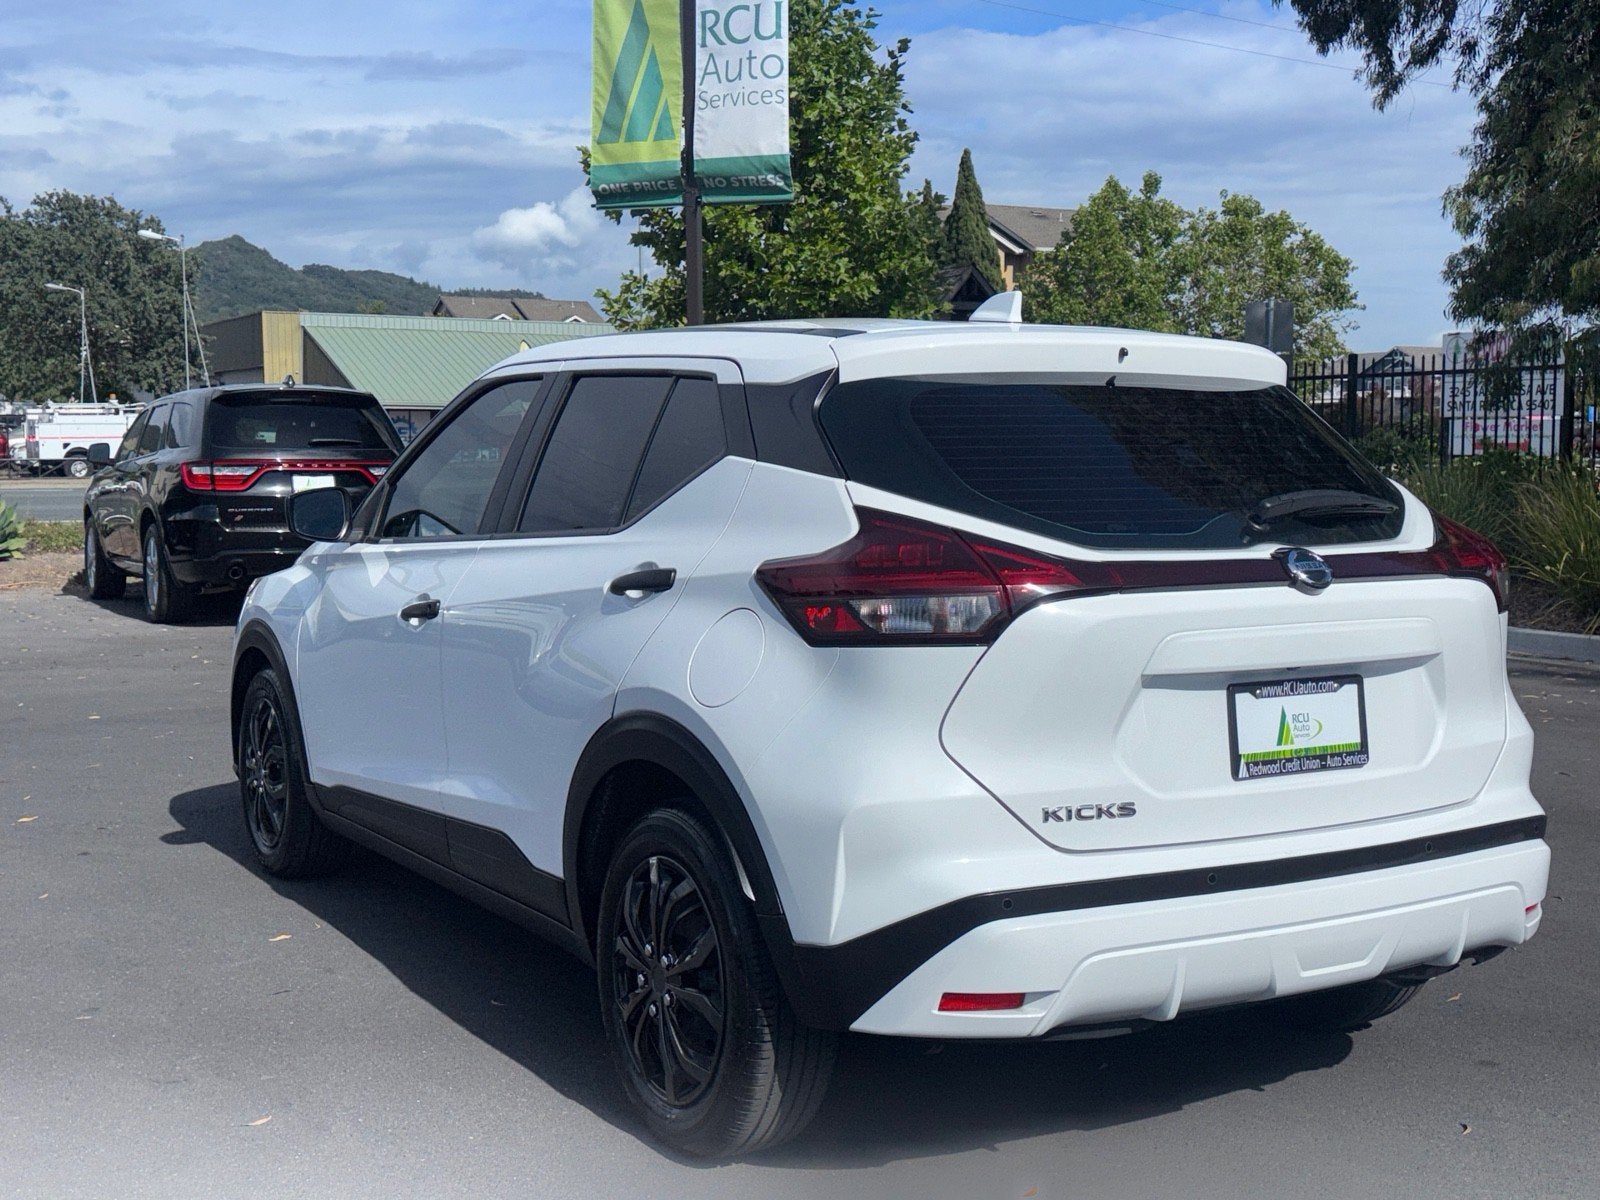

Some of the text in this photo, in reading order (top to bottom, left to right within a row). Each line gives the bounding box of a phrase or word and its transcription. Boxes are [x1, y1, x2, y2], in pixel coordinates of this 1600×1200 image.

[700, 1, 782, 48] RCU
[700, 50, 784, 86] Auto
[699, 86, 785, 110] Services
[598, 180, 677, 195] ONE PRICE
[703, 174, 784, 188] NO STRESS
[1261, 681, 1335, 696] www.RCUauto.com
[1292, 712, 1310, 724] RCU
[1293, 724, 1310, 732] Auto
[1249, 763, 1280, 776] Redwood
[1281, 760, 1300, 772] Credit
[1301, 757, 1320, 770] Union
[1327, 755, 1342, 767] Auto
[1342, 752, 1368, 766] Services
[1042, 802, 1137, 823] KICKS
